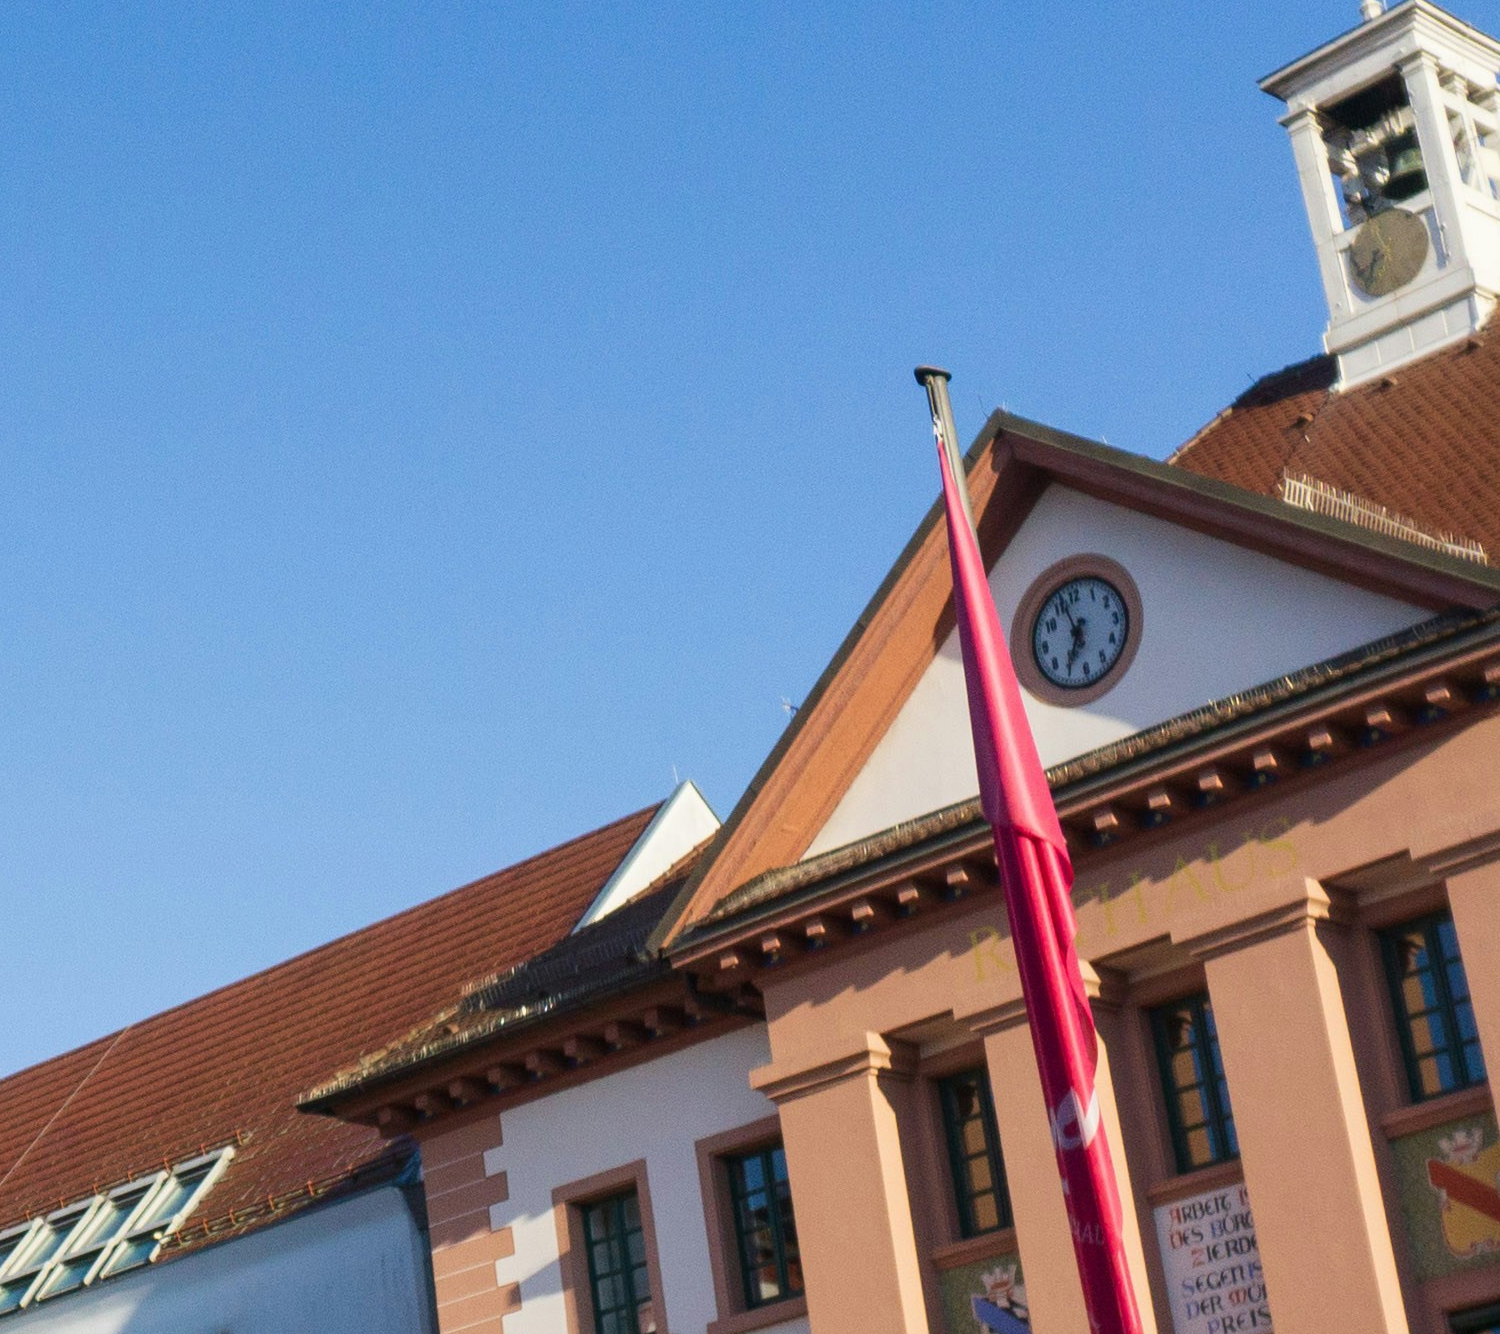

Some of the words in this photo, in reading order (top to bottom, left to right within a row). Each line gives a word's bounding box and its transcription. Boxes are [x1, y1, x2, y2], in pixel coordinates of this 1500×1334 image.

[968, 817, 1299, 983] RHAUS
[1169, 1193, 1233, 1228] ARBEIT
[1185, 1294, 1224, 1321] DER
